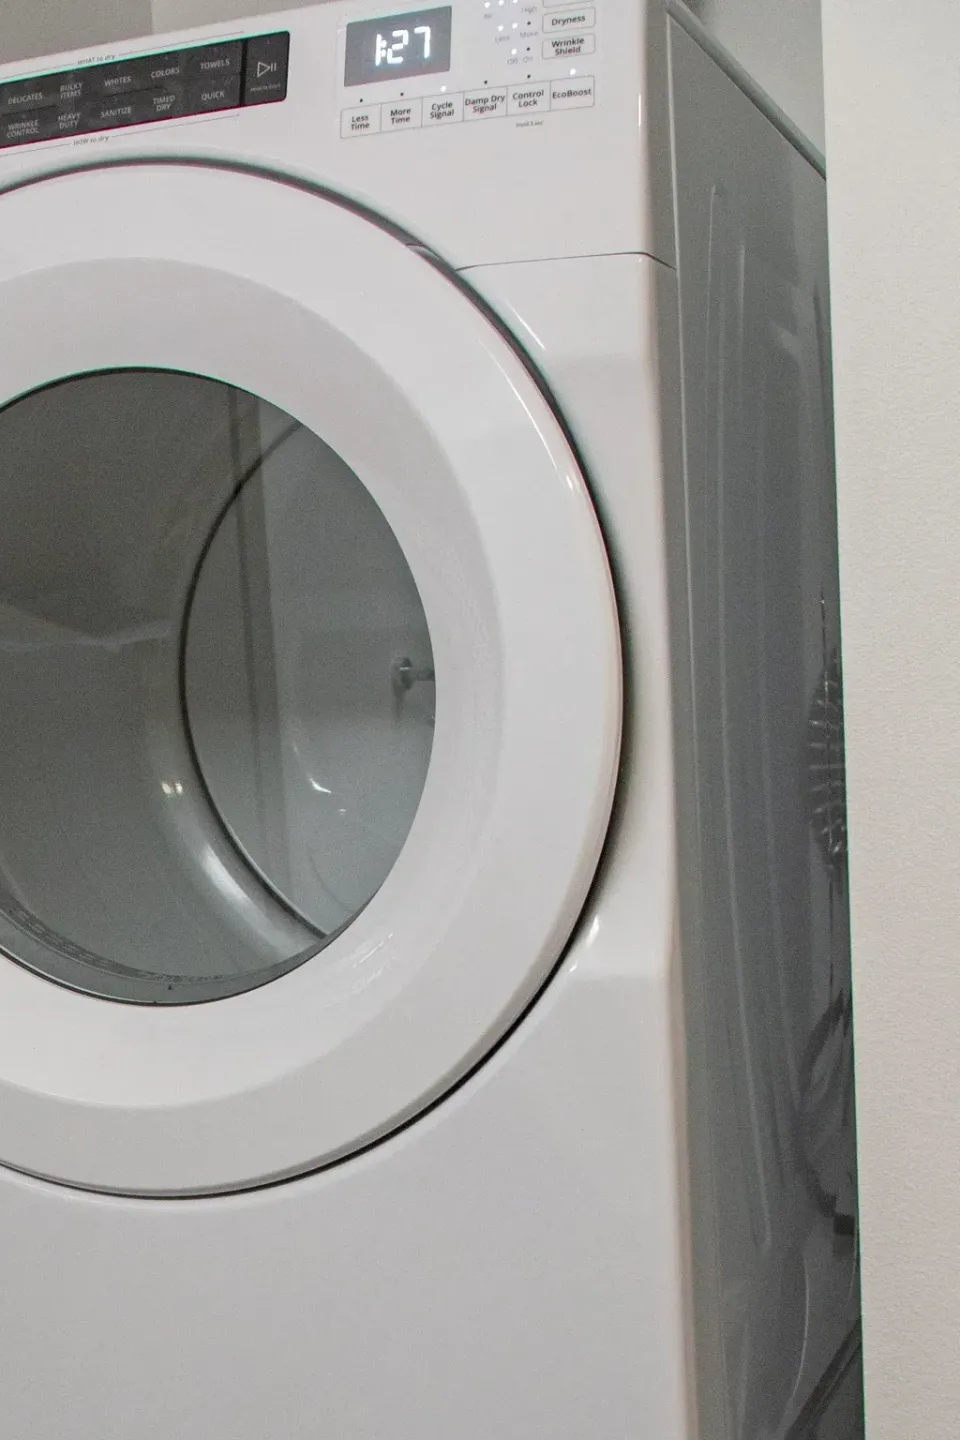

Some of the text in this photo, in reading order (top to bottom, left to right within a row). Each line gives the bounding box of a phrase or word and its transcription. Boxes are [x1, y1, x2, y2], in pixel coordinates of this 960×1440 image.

[551, 15, 586, 27] Dryness
[520, 31, 538, 39] More
[375, 26, 431, 66] 1:27
[551, 37, 585, 48] Wrinkle
[554, 46, 581, 56] Shield
[200, 59, 230, 70] TOWELS
[151, 67, 180, 79] COLORS
[60, 82, 83, 92] BULKY
[104, 76, 132, 88] WHITES
[8, 92, 43, 105] DELICATES
[60, 90, 81, 99] ITEMS
[201, 91, 225, 101] QUICK
[512, 89, 545, 100] Control
[552, 88, 592, 99] EcoBoost
[153, 95, 176, 105] TIMED
[465, 94, 505, 106] Damp Dry
[518, 98, 538, 108] Lock
[100, 106, 132, 118] SANITIZE
[156, 103, 172, 112] DRY
[431, 101, 453, 112] Cycle
[472, 103, 497, 114] Signal
[58, 112, 81, 123] HEAVY
[390, 108, 411, 117] More
[430, 109, 455, 120] Signal
[351, 115, 369, 123] Less
[391, 116, 410, 125] Time
[8, 120, 39, 131] WRINKLE
[59, 120, 78, 130] DUTY
[351, 123, 370, 131] Time
[6, 128, 39, 138] CONTROL
